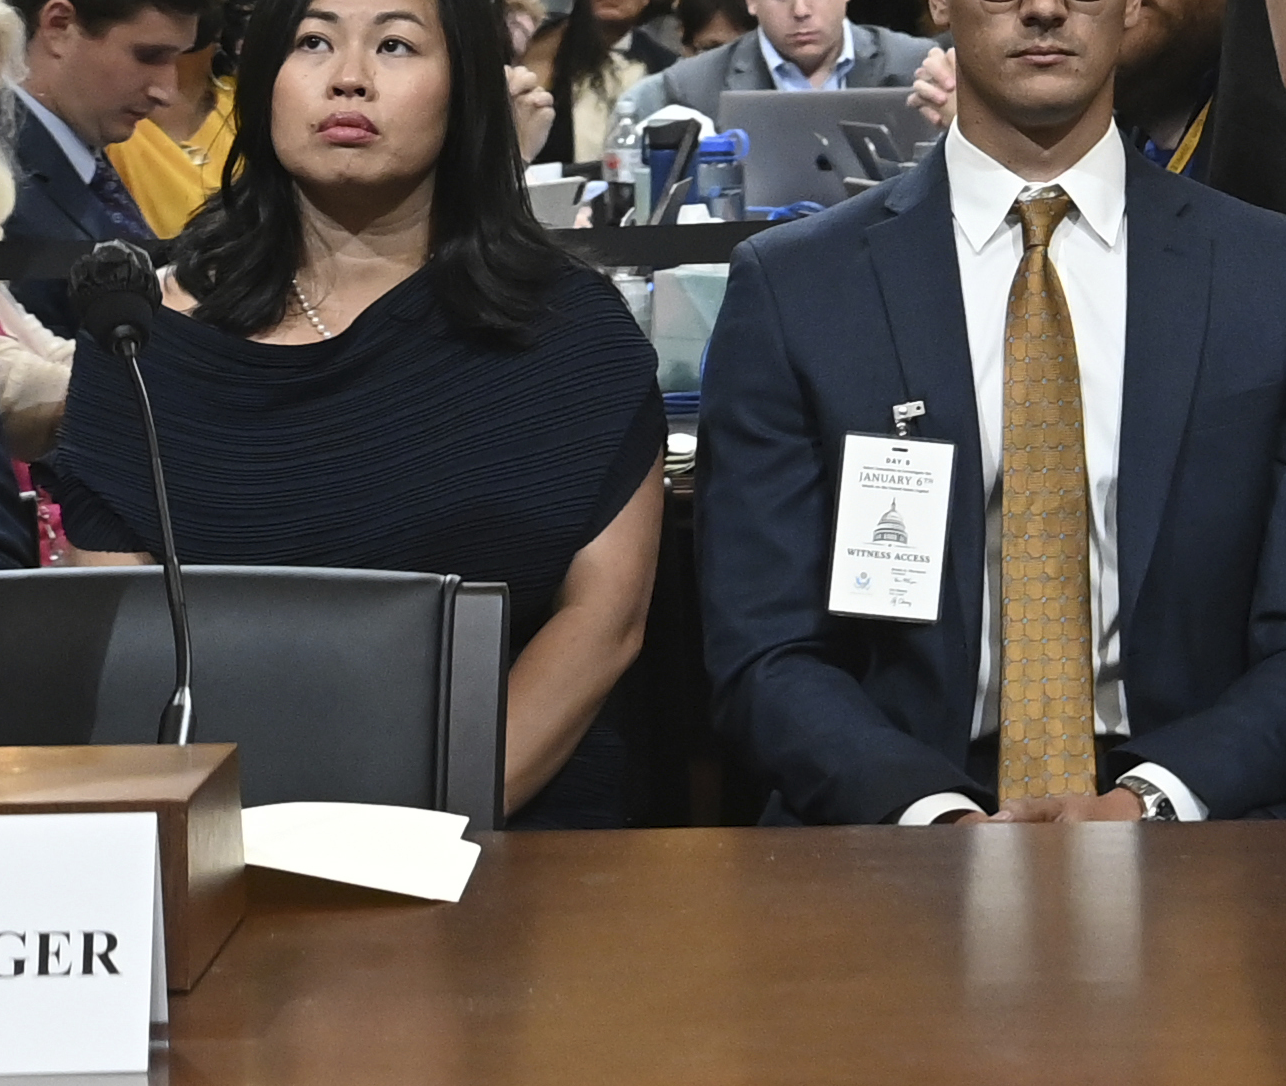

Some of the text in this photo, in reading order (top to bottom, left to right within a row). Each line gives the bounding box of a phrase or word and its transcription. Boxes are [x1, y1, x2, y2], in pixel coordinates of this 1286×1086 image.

[886, 457, 902, 465] DAY
[859, 472, 912, 485] JANUARY
[847, 548, 930, 563] WITNESS ACCESS
